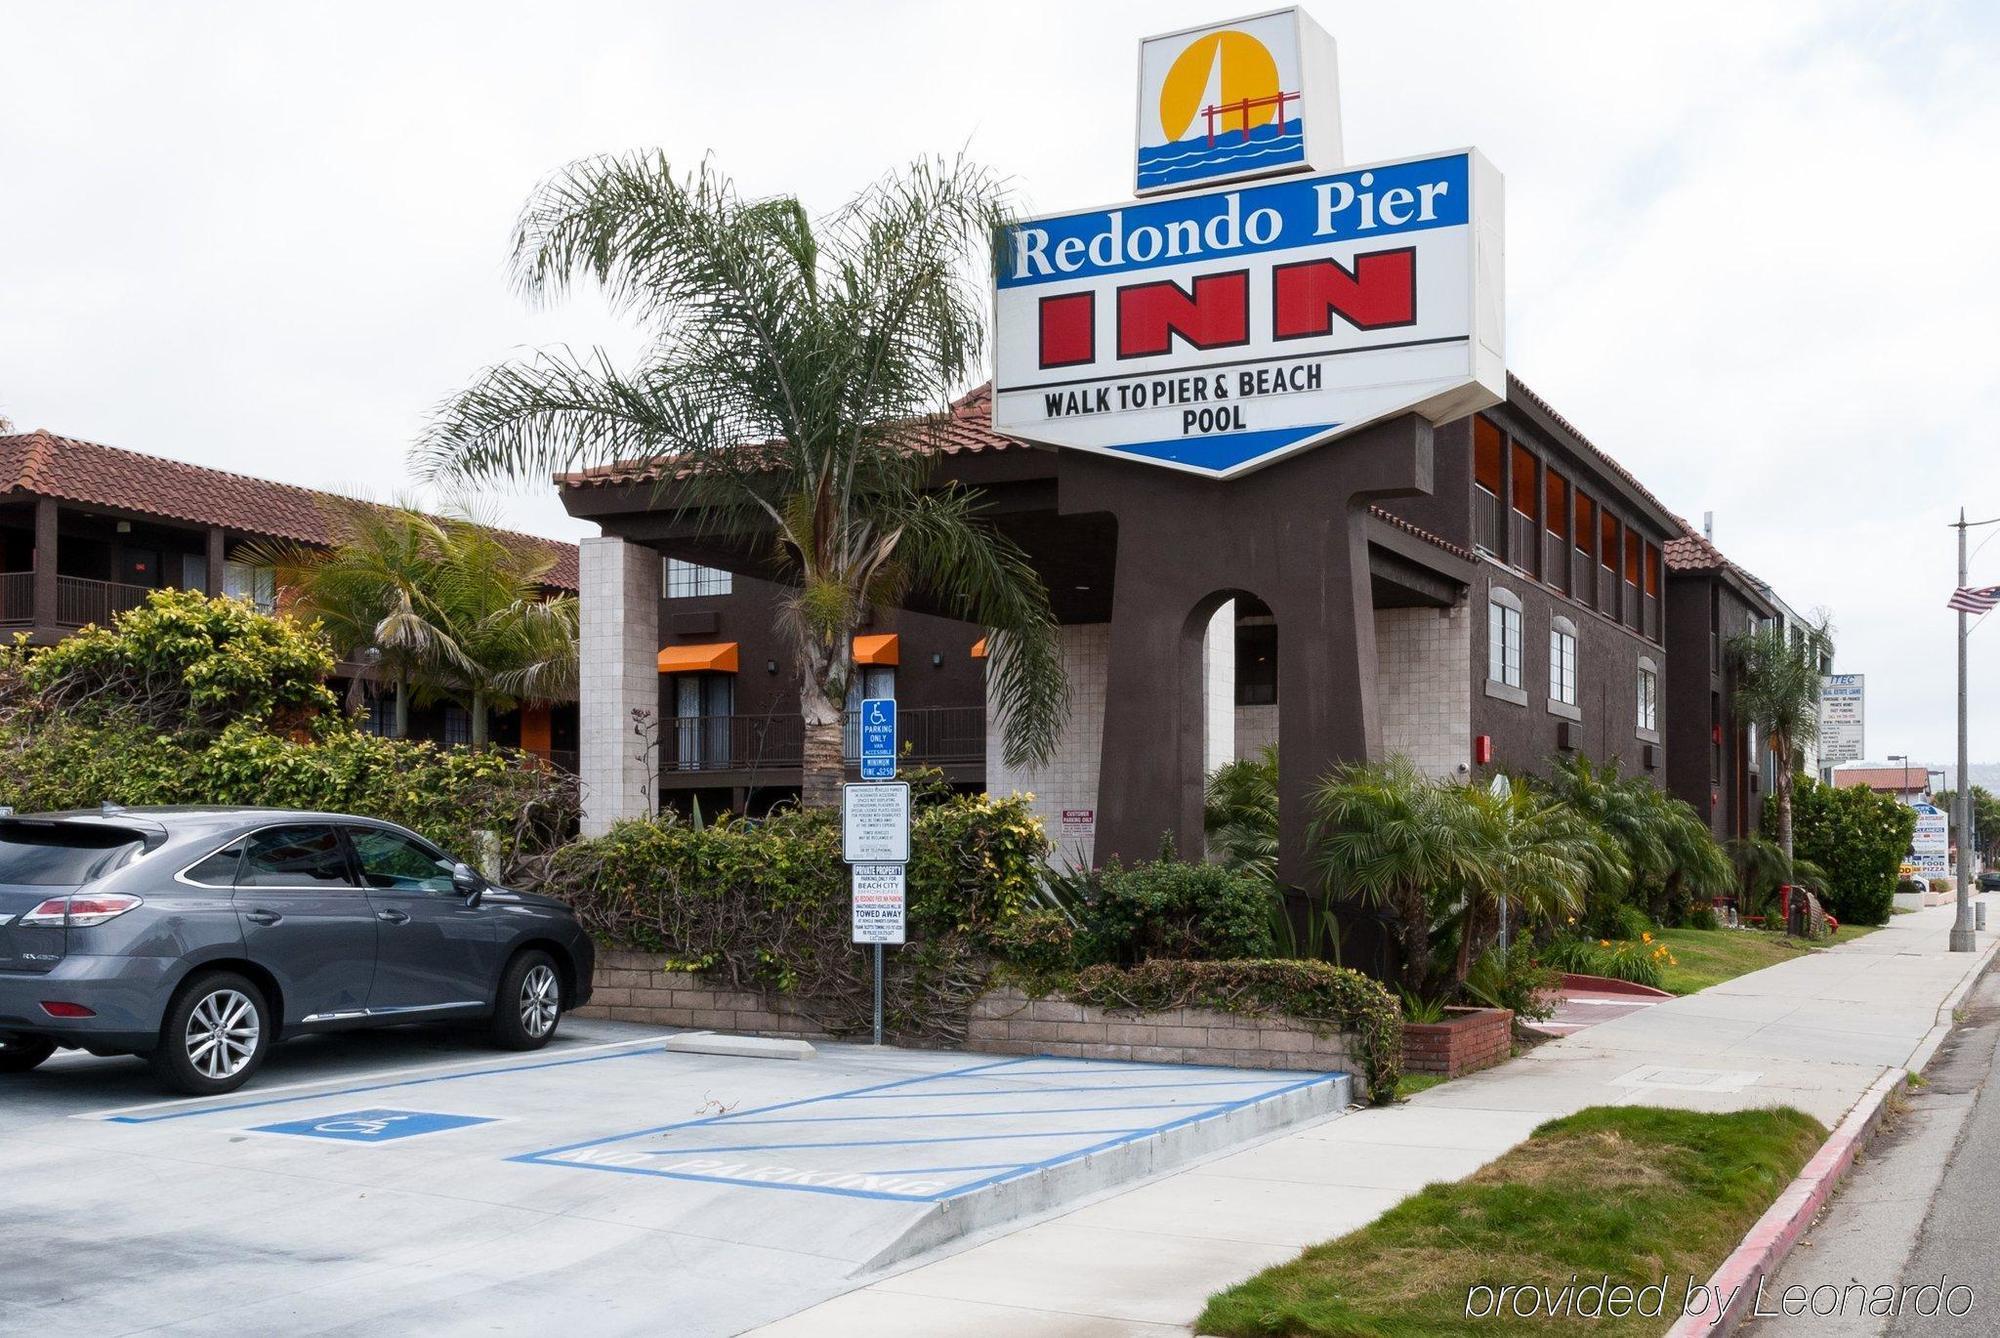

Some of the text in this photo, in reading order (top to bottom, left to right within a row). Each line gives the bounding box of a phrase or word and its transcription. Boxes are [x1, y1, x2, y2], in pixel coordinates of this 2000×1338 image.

[1012, 172, 1449, 280] Redondo Pier
[1038, 246, 1418, 370] INN
[1045, 363, 1323, 418] WALK TO PIER & BEACH
[1182, 404, 1247, 435] POOL
[1830, 676, 1855, 684] ITEC
[870, 734, 887, 742] ONLY
[856, 866, 901, 875] PRIVATE PROPERTY
[657, 1158, 947, 1195] PARKING
